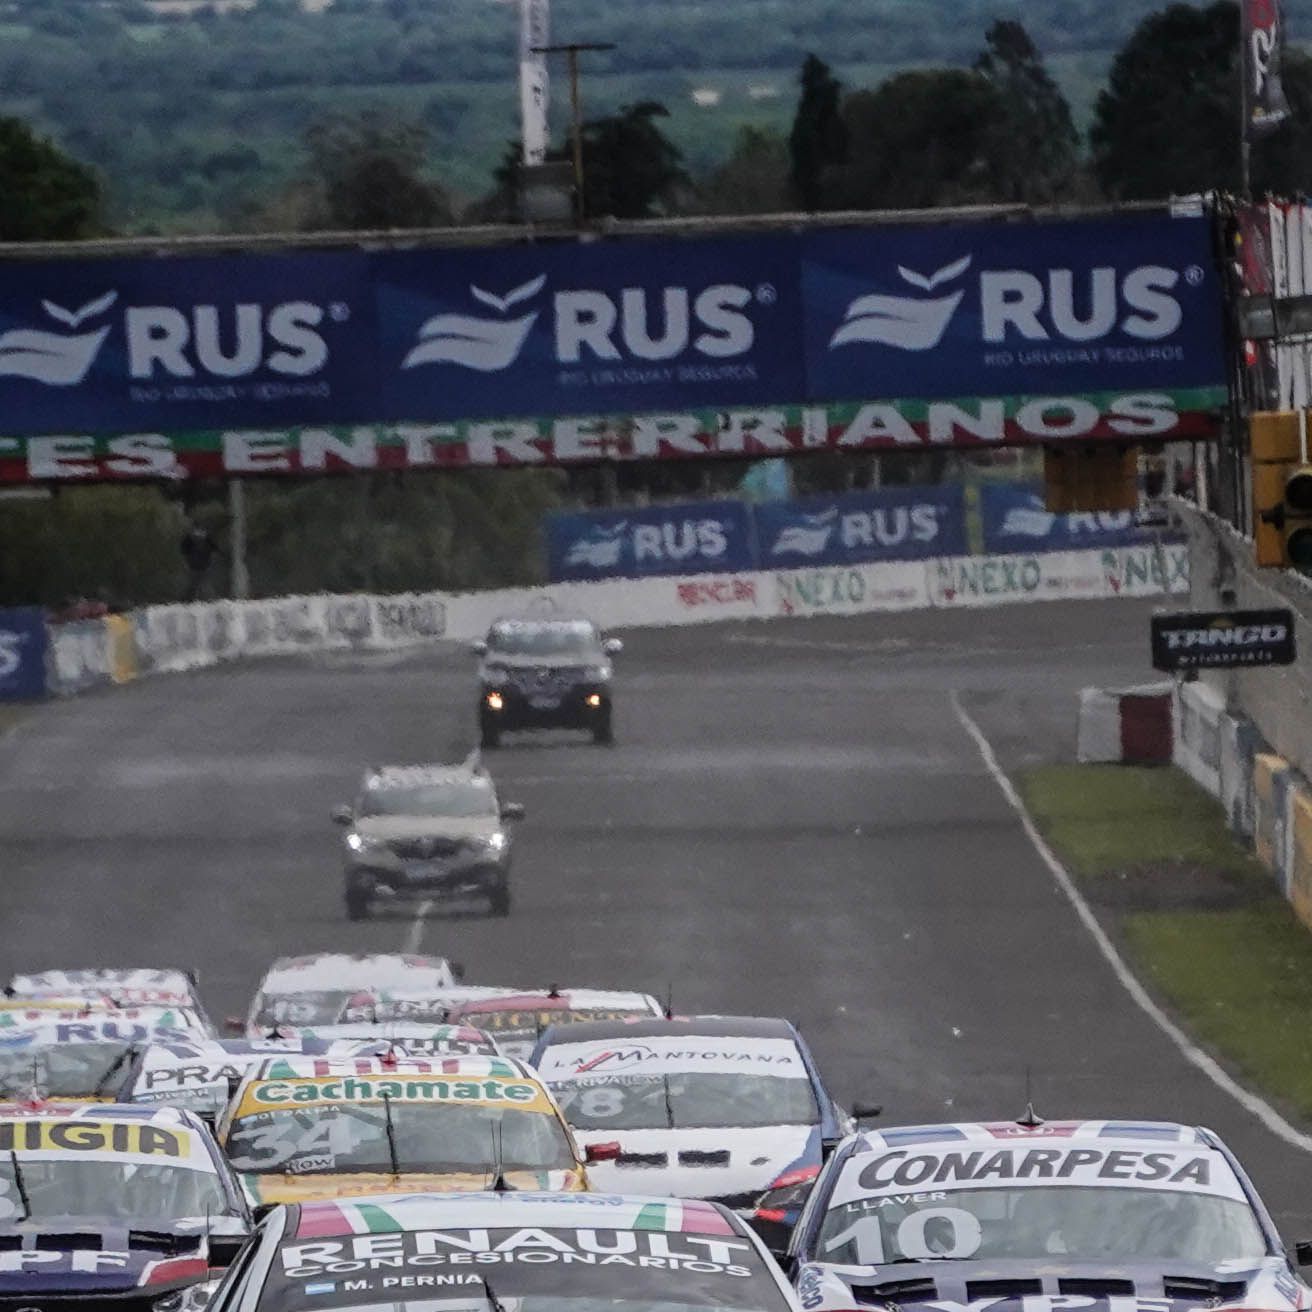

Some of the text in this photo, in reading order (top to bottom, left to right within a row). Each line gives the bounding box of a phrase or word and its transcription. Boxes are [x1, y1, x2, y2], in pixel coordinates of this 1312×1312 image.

[554, 284, 754, 362] RUS
[980, 265, 1183, 342] RUS
[125, 301, 329, 378] RUS
[221, 392, 1181, 471] ENTRERRIANOS
[632, 519, 727, 559] RUS
[842, 504, 938, 548] RUS
[1161, 624, 1288, 649] TANGO
[608, 1049, 794, 1065] MANTOVANA
[255, 1077, 535, 1104] Cachamate
[858, 1148, 1212, 1190] CONARPESA
[847, 1191, 947, 1213] LLAVER
[282, 1228, 750, 1269] RENAULT
[825, 1207, 984, 1266] 10
[285, 1251, 754, 1279] CONCESIONARIOS
[344, 1273, 486, 1293] M. PERNIA
